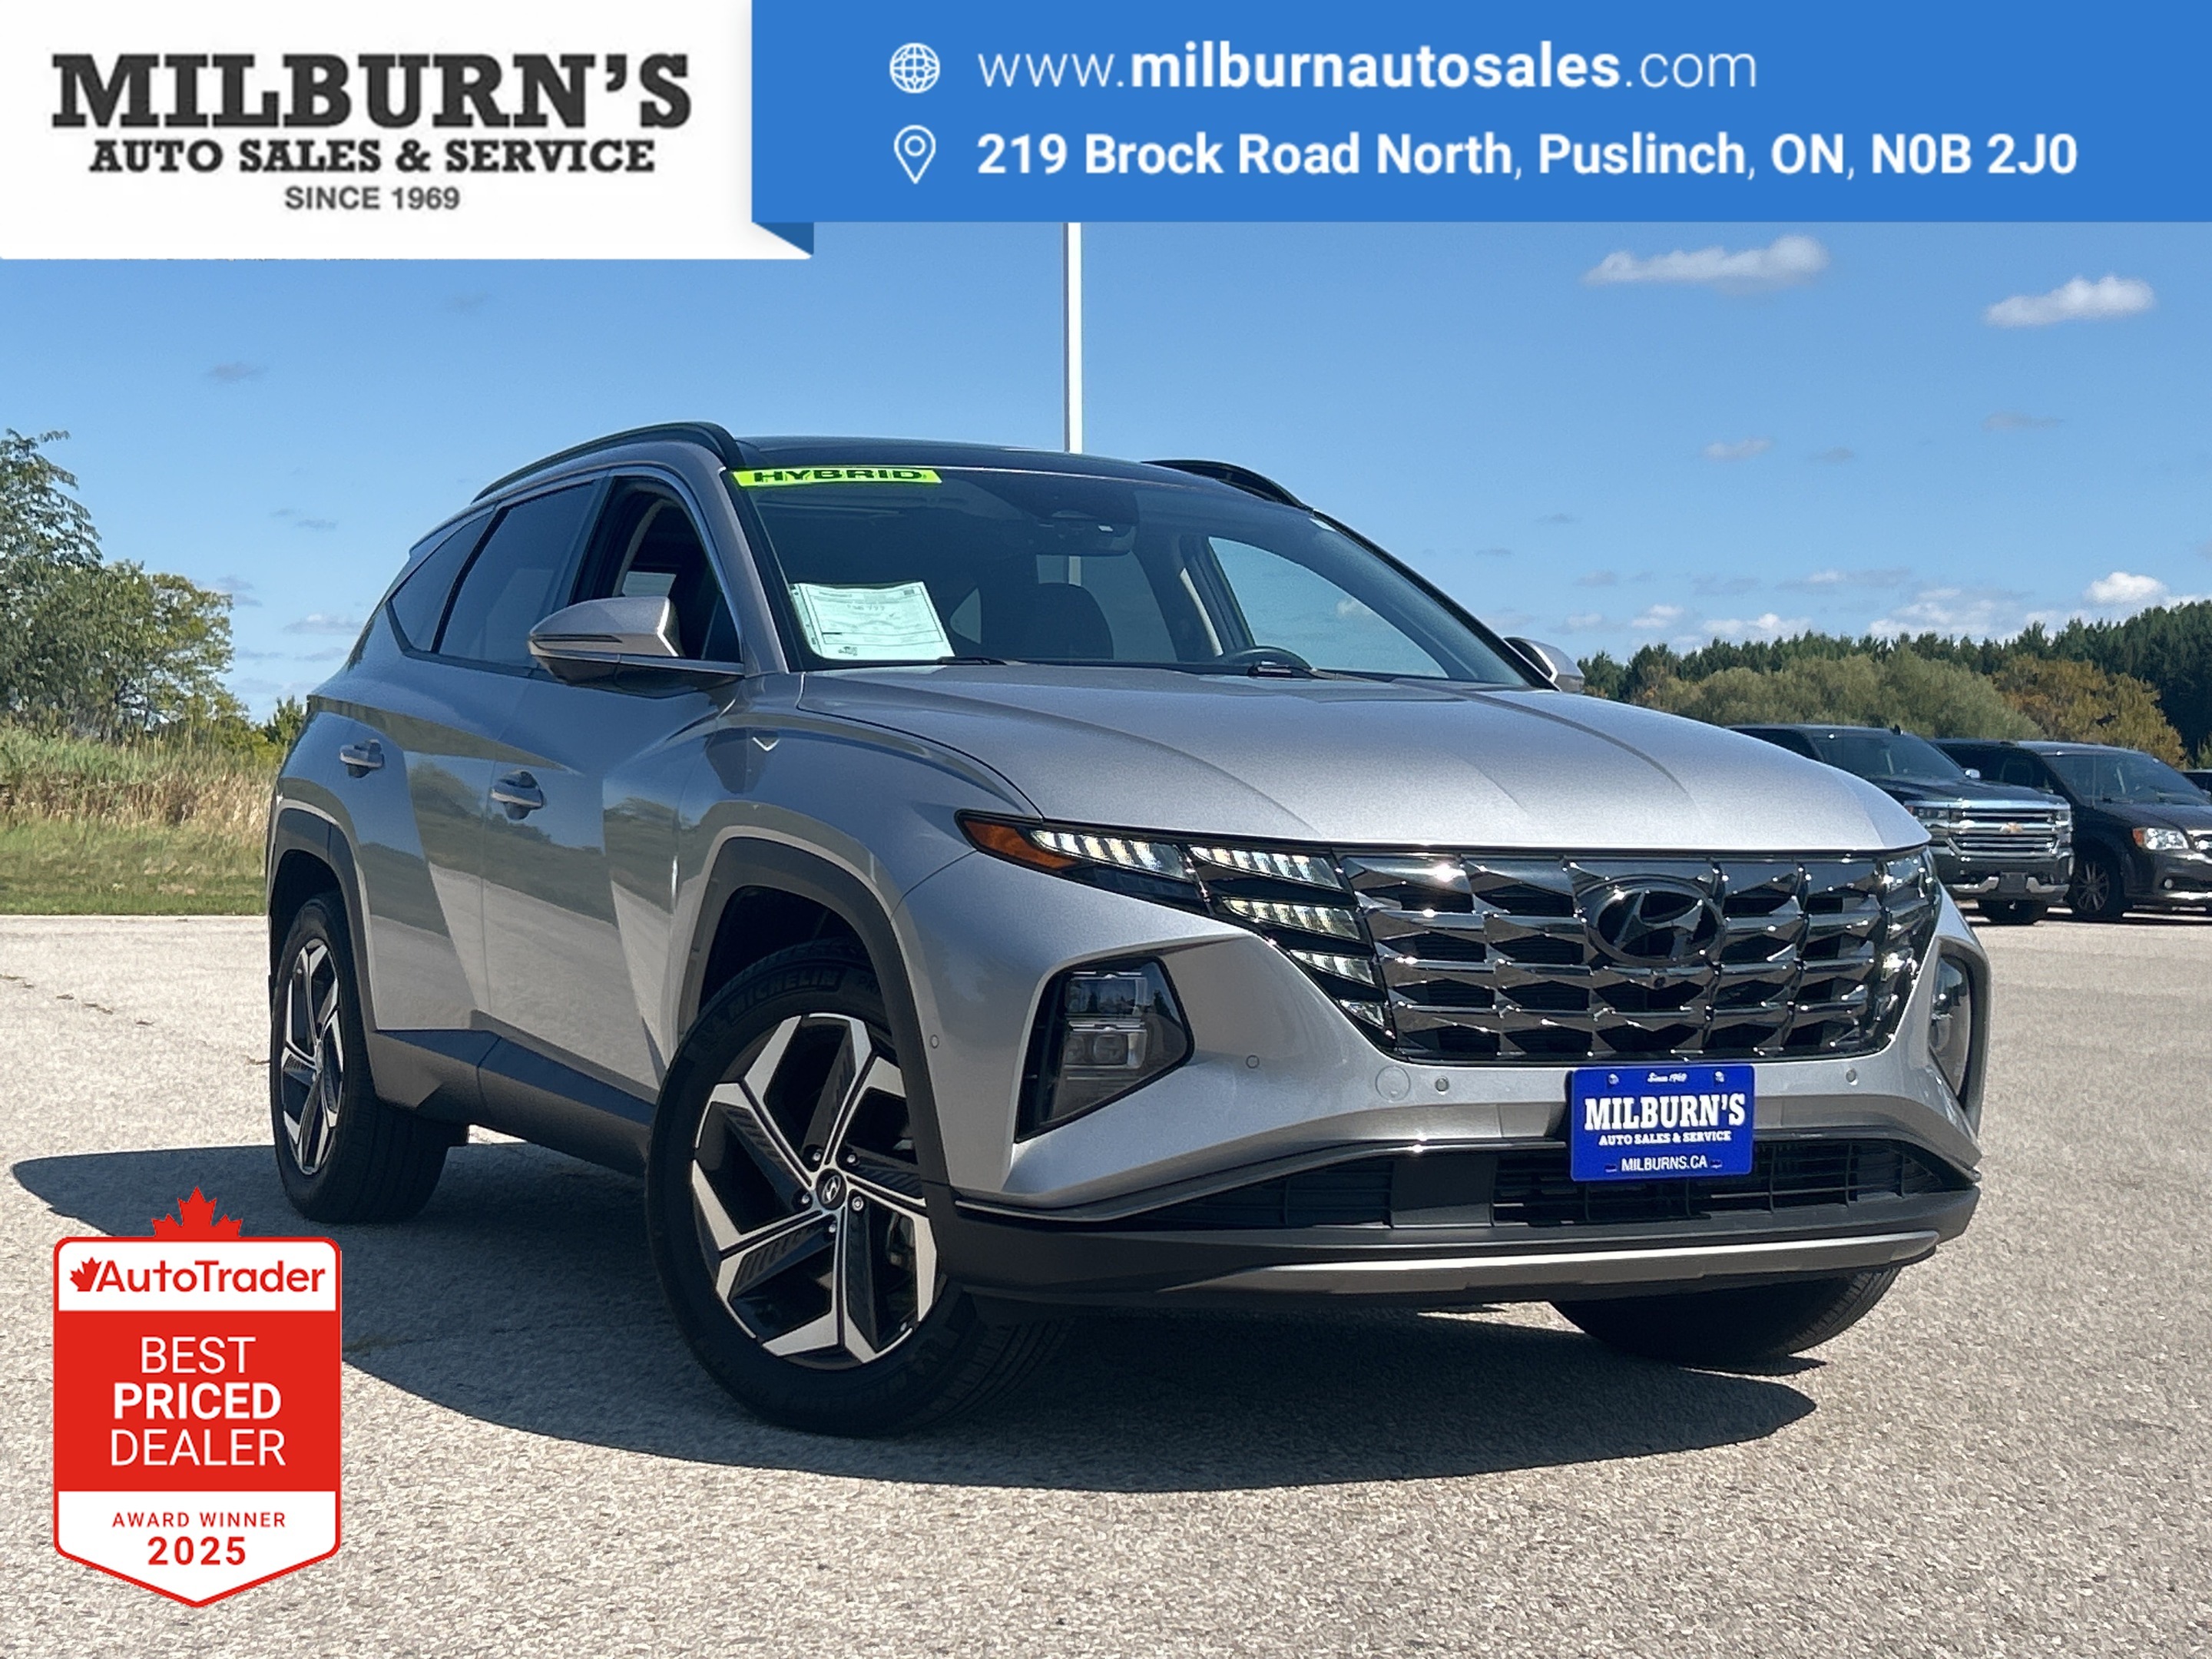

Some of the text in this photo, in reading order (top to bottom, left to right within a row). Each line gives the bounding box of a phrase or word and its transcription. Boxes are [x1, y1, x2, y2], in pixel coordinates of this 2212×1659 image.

[754, 469, 927, 483] HYBRID
[729, 969, 841, 1016] MICHELIN
[1584, 1093, 1746, 1131] MILBURN'S
[1598, 1131, 1731, 1145] AUTO SALES & SERVICE
[1621, 1155, 1707, 1172] MILBURNS.CA
